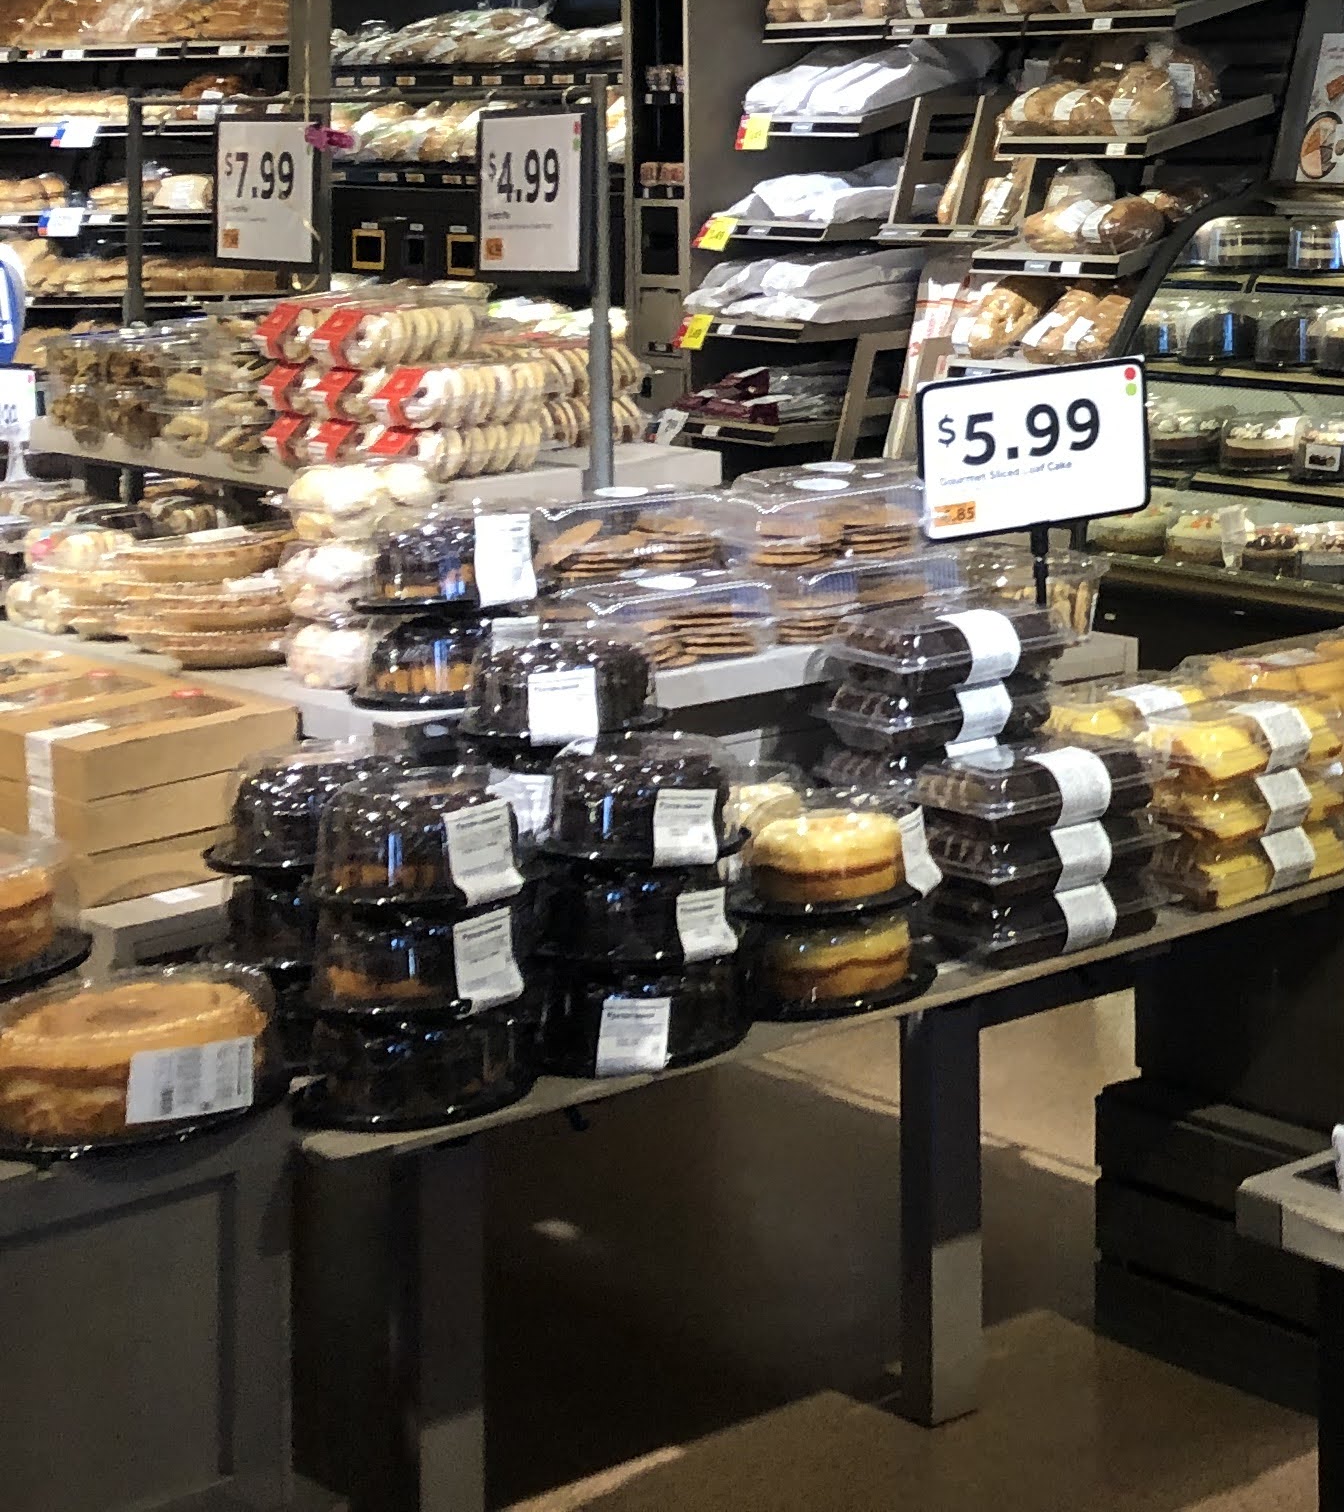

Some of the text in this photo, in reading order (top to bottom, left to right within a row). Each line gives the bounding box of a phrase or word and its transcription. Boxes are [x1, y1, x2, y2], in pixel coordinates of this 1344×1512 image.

[224, 151, 295, 200] $7.99
[487, 148, 560, 204] $4.99
[938, 398, 1100, 466] $5.99
[1047, 461, 1073, 472] Cake
